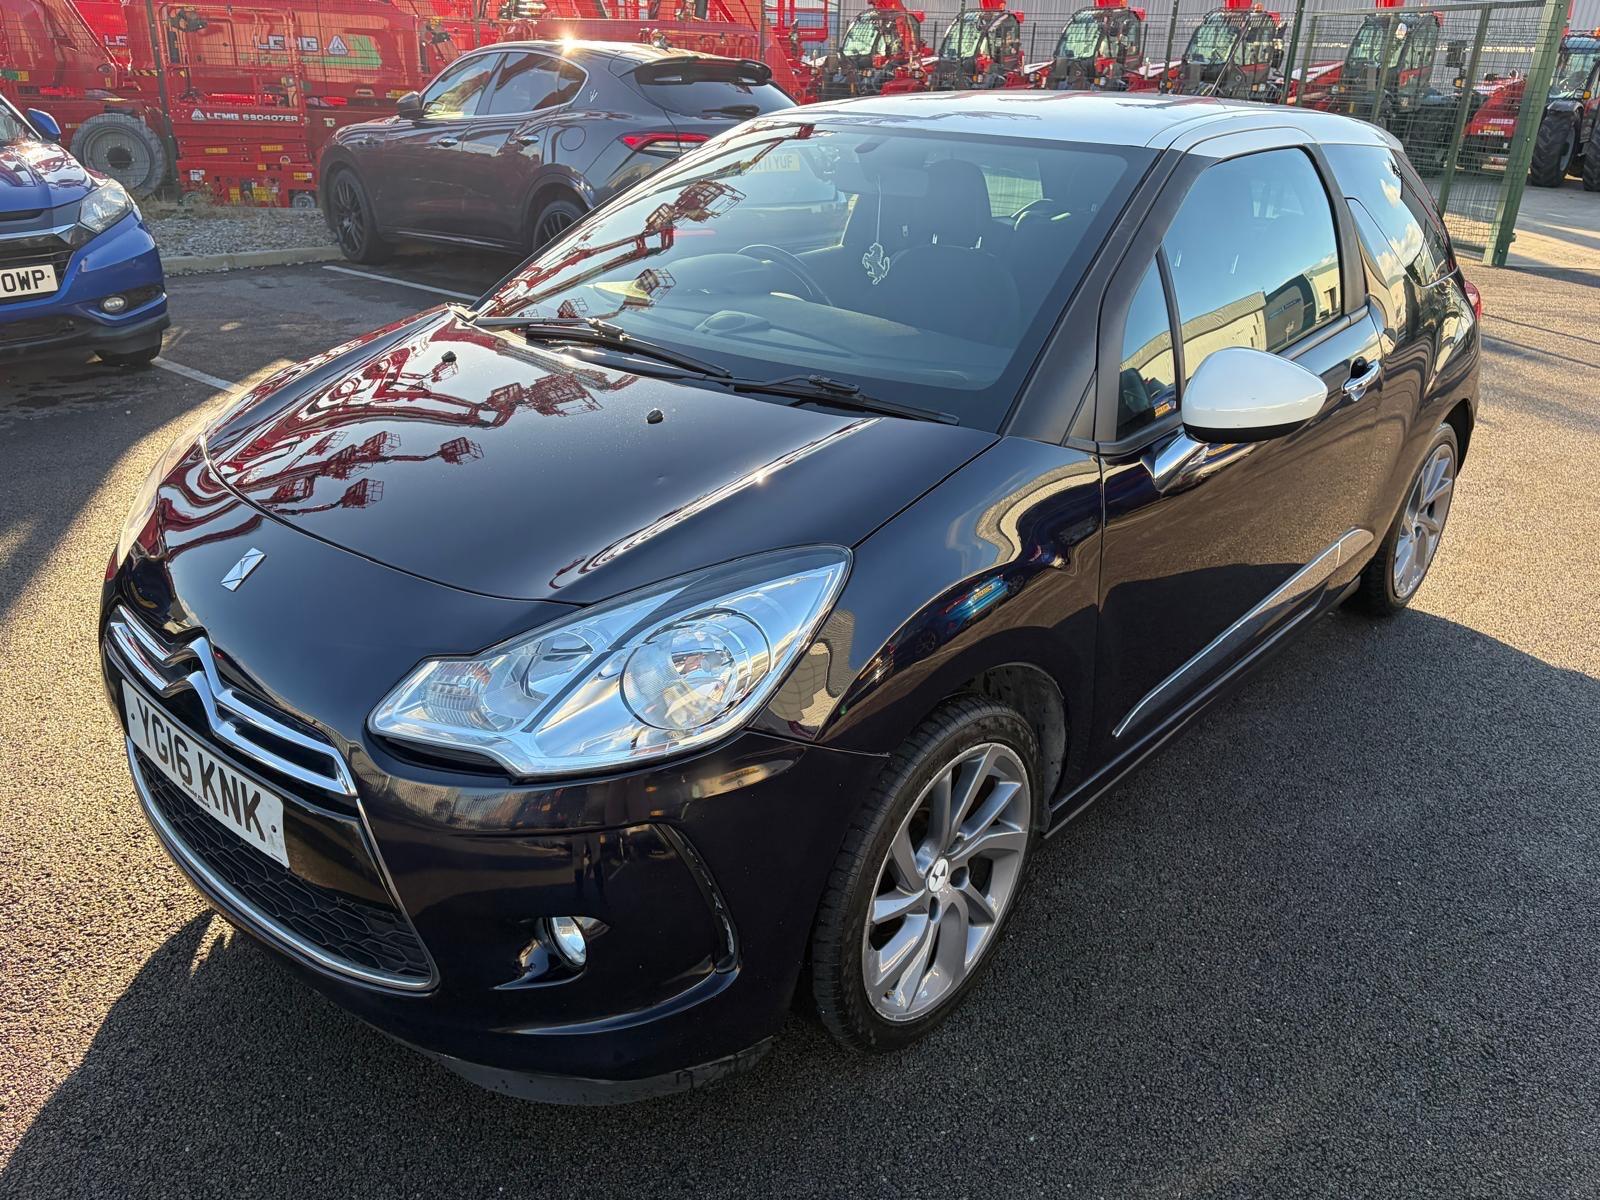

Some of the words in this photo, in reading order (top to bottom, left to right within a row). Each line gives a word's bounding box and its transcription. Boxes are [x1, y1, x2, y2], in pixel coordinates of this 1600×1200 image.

[1, 269, 46, 292] OWP
[136, 697, 193, 786] YG16
[198, 752, 266, 842] KNK
